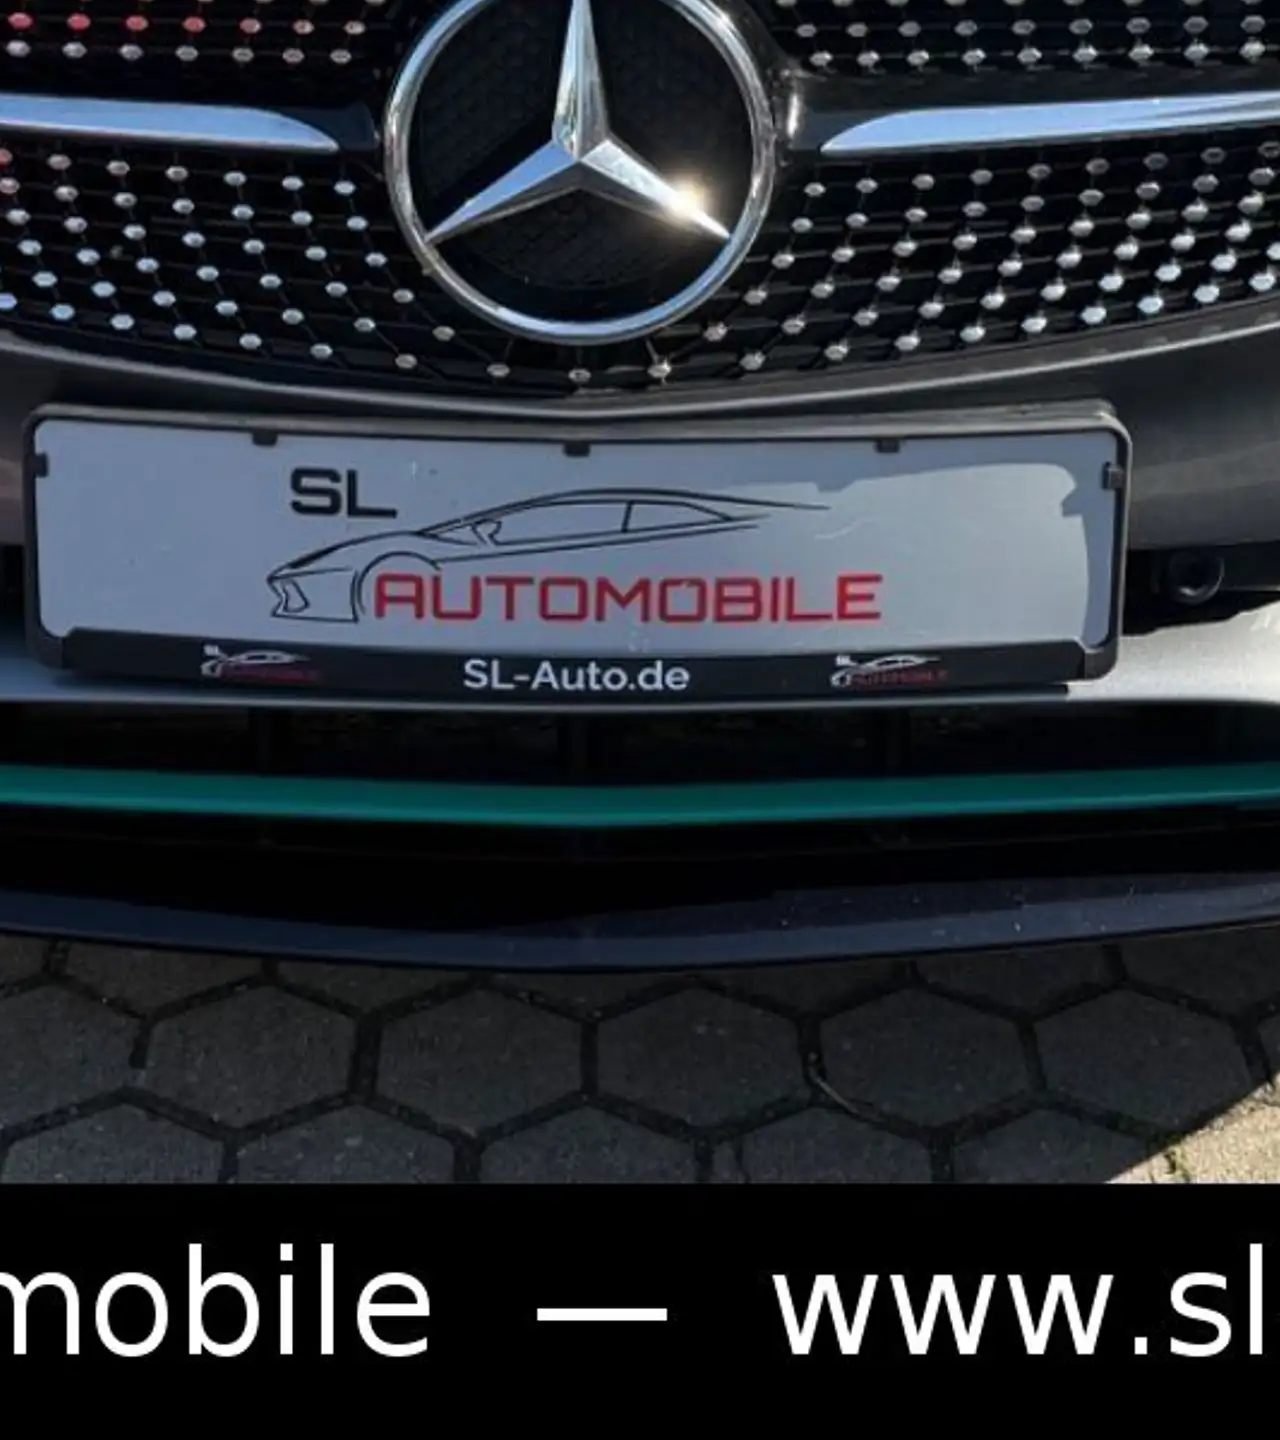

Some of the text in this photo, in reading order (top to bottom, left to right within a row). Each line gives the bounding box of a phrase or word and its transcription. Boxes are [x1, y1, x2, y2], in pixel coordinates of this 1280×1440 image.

[290, 467, 398, 519] SL
[374, 573, 883, 624] AUTOMOBILE
[463, 660, 691, 692] SL-Auto.de
